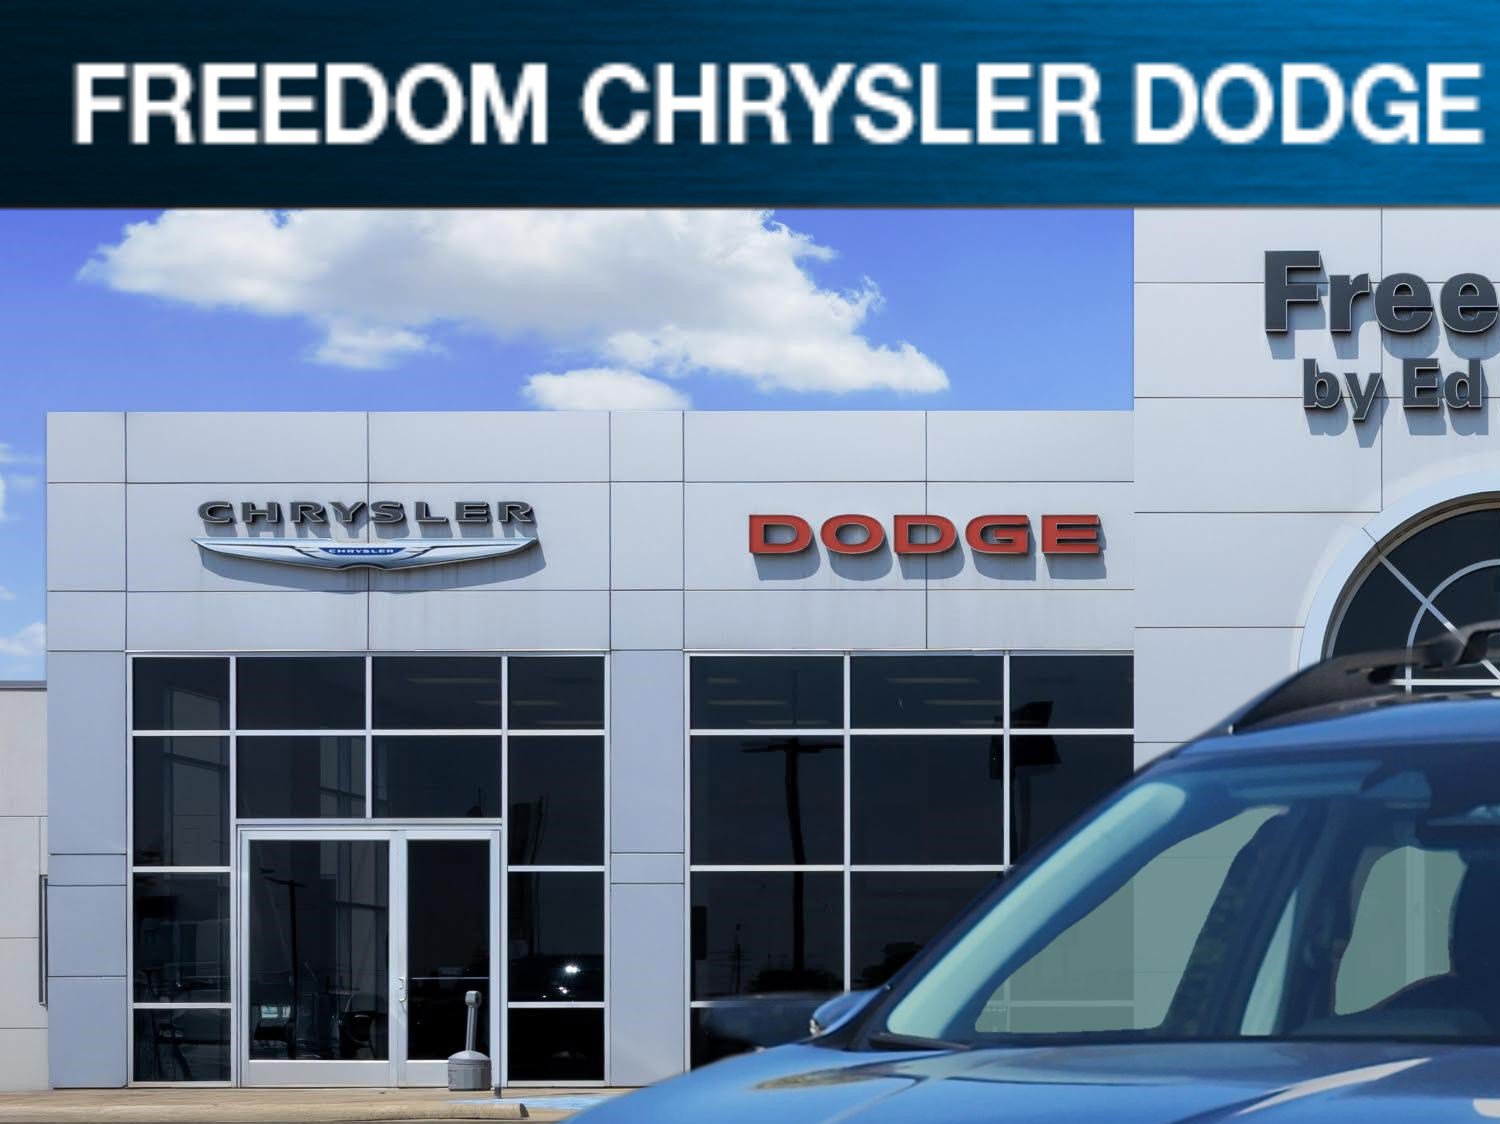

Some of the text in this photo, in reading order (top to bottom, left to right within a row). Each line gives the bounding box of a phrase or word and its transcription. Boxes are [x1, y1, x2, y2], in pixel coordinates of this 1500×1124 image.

[1303, 358, 1382, 421] by
[1402, 358, 1482, 409] Ed
[197, 500, 535, 524] CHRYSLER
[748, 514, 1103, 556] DODGE
[328, 548, 395, 556] CHRYSLER
